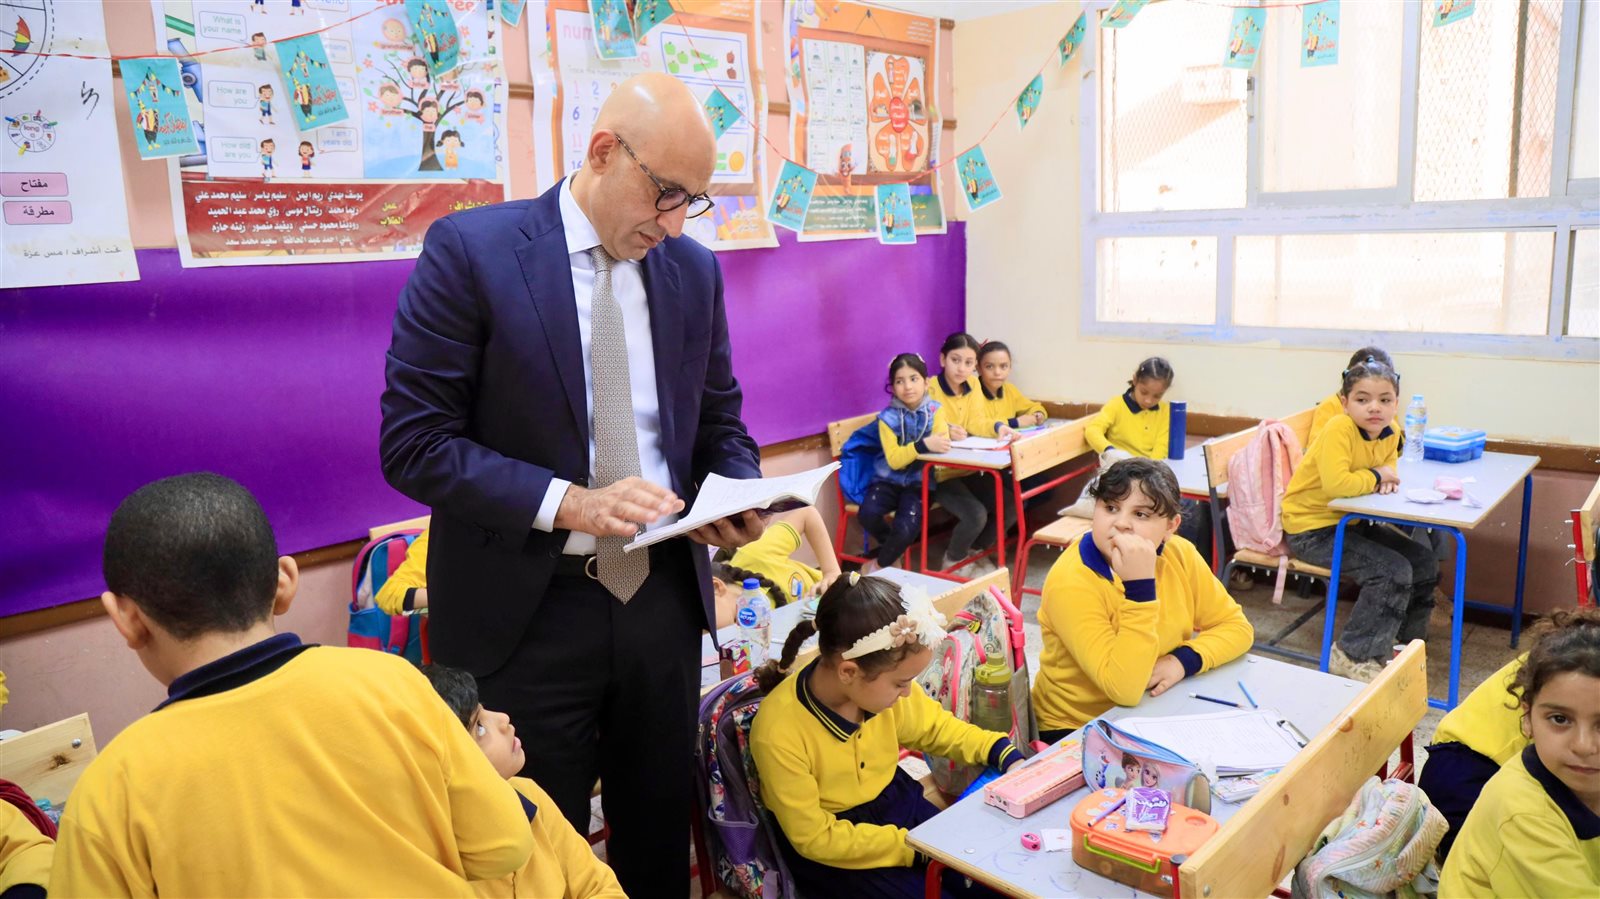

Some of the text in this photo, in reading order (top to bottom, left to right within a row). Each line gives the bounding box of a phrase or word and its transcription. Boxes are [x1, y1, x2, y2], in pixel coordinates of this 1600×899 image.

[213, 15, 233, 25] What
[203, 25, 242, 34] your name
[216, 86, 233, 94] How
[574, 80, 580, 94] 1
[592, 81, 599, 95] 2
[233, 97, 248, 105] you
[572, 106, 599, 120] 6 7
[23, 124, 40, 134] long
[221, 141, 238, 149] How
[572, 134, 582, 147] 11
[238, 151, 251, 159] you
[21, 178, 48, 192] مفتاح
[194, 190, 210, 204] علي
[210, 190, 230, 200] محمد
[345, 190, 364, 201] يوسف
[23, 205, 54, 219] مطرقة
[207, 206, 232, 218] الحميد
[233, 207, 248, 217] عبد
[248, 207, 266, 215] محمد
[328, 206, 345, 214] محمد
[241, 237, 259, 245] محمد
